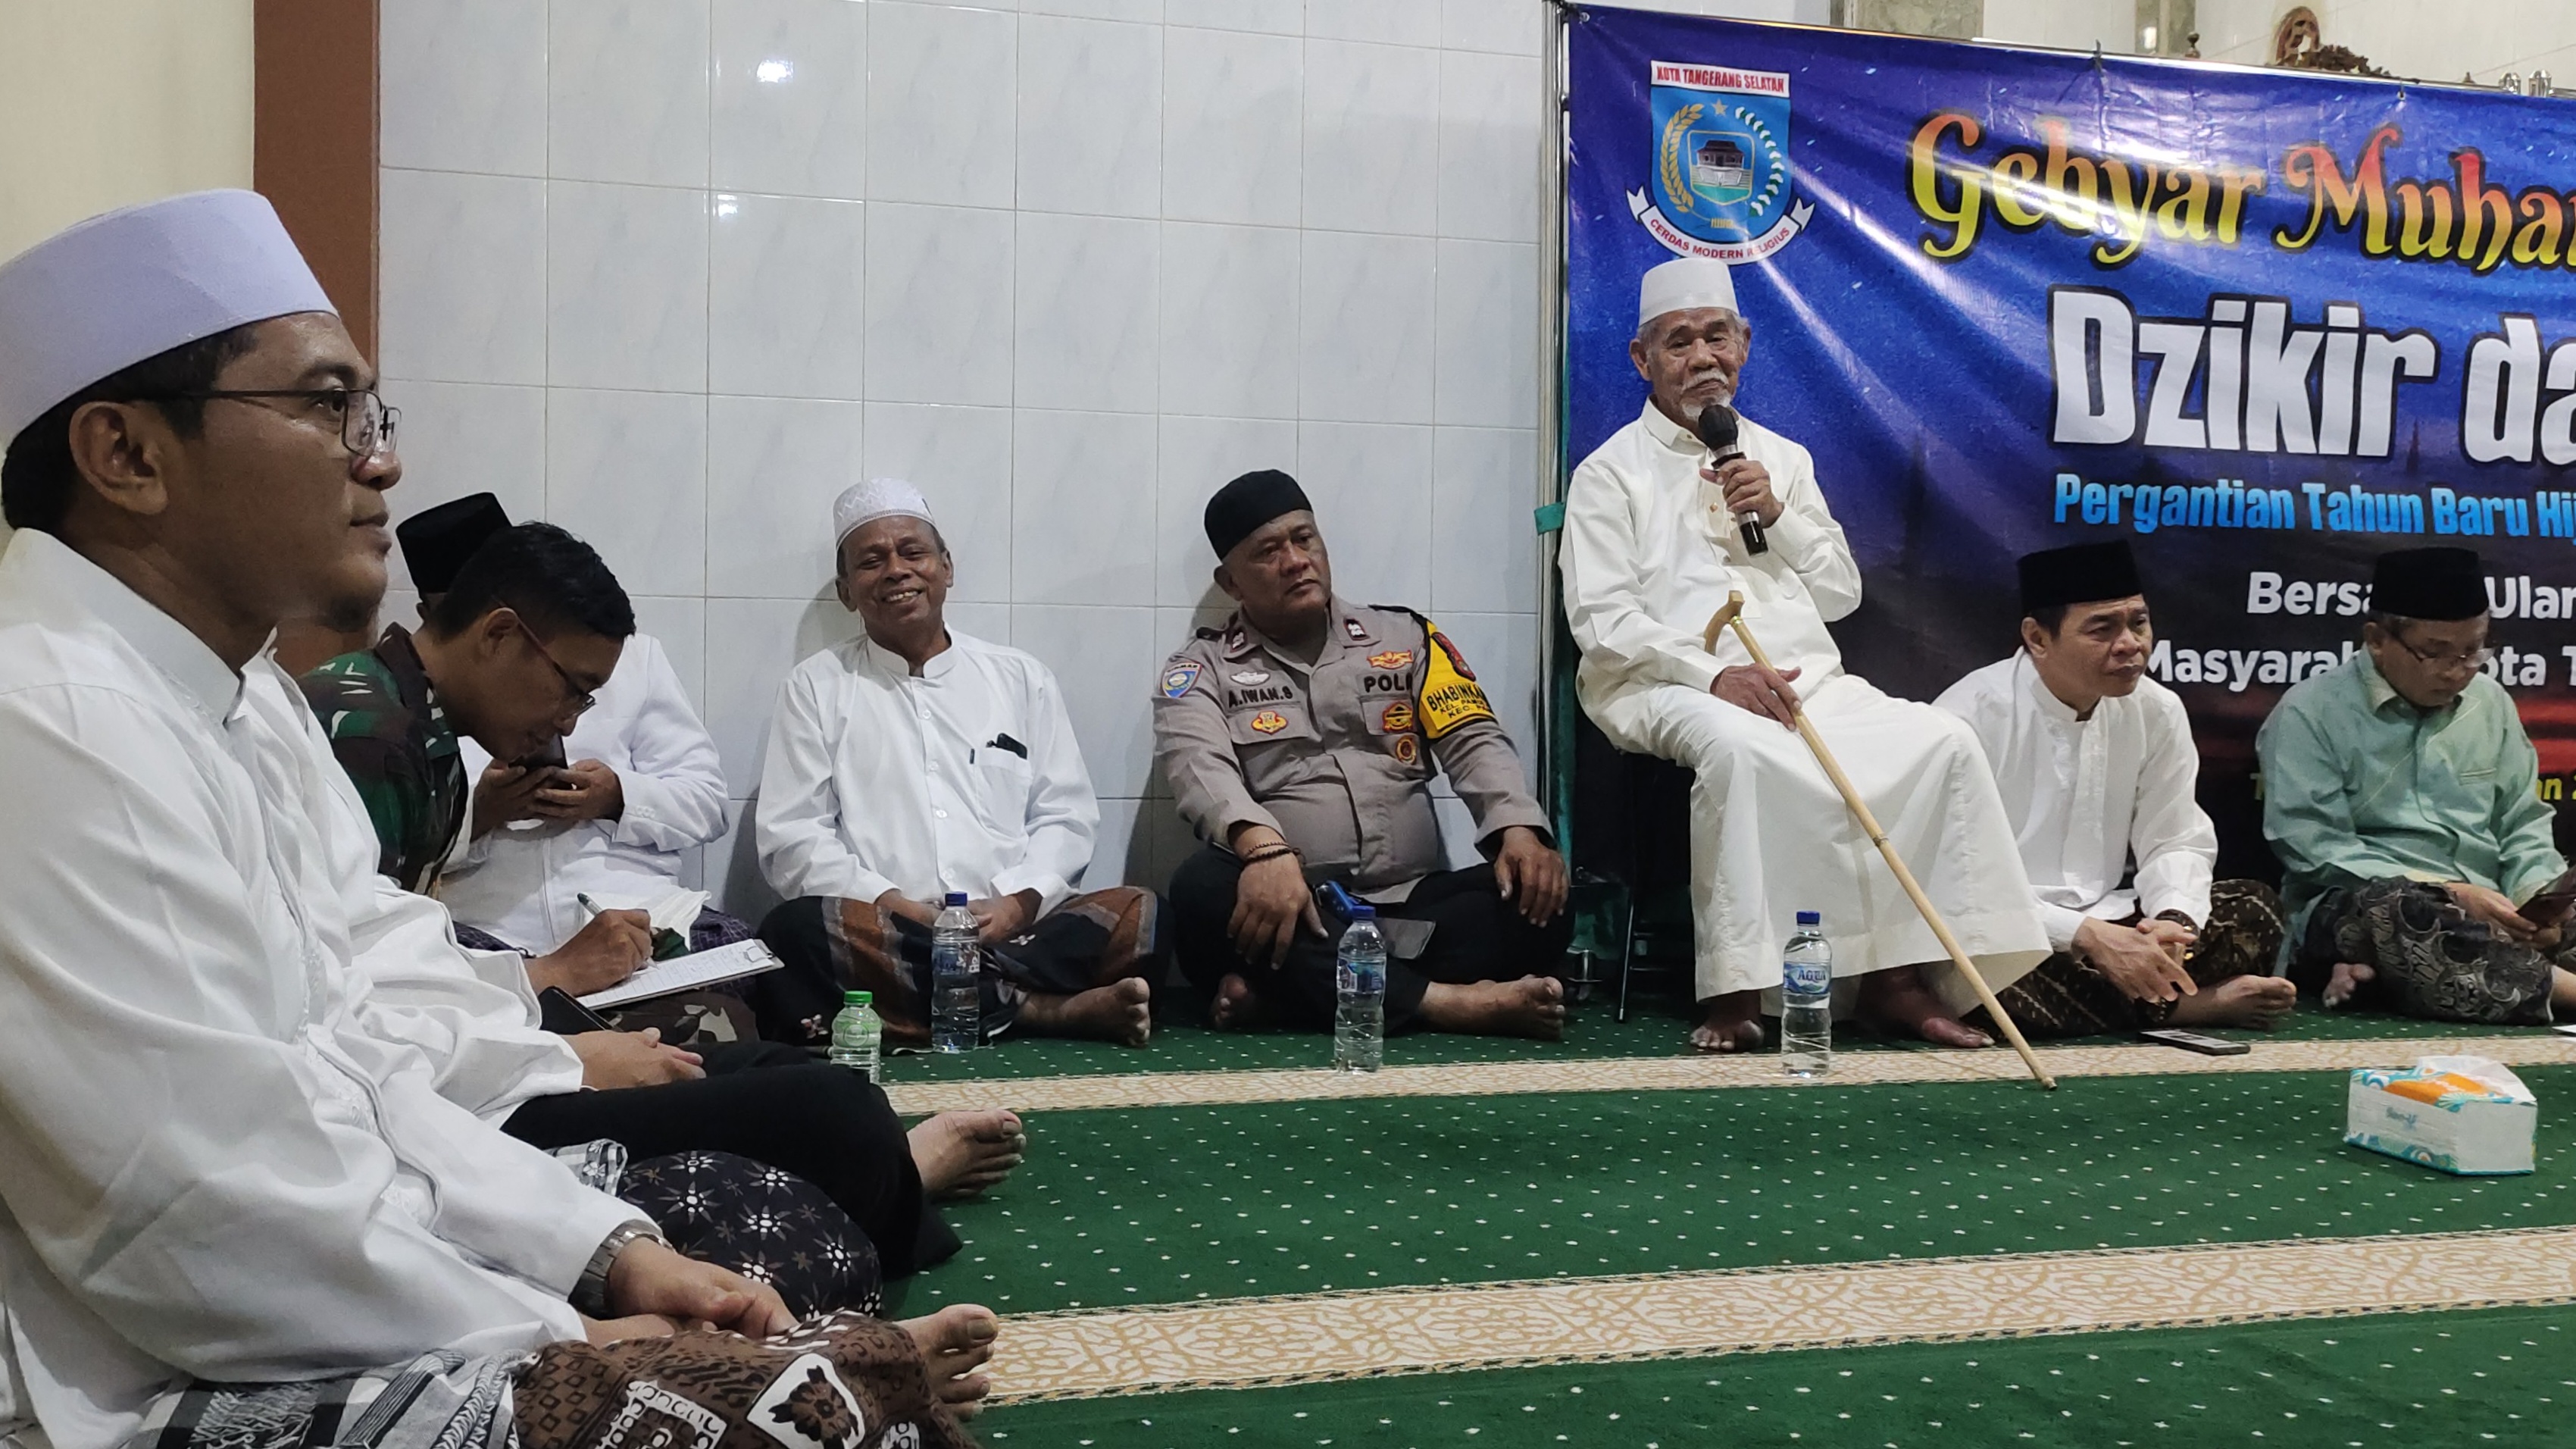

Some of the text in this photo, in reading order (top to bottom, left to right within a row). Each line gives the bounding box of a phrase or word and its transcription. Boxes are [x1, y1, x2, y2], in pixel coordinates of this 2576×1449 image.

[1656, 65, 1784, 93] KOTA TANGERANG SELATAN
[1909, 112, 2576, 272] Gebyar Muha
[1649, 218, 1690, 252] CERDAS
[1692, 244, 1743, 259] MODERN
[2052, 289, 2576, 466] Dzikir da
[2053, 473, 2576, 546] Pergantian Tahun Baru Hi
[1797, 969, 1827, 983] AQUA
